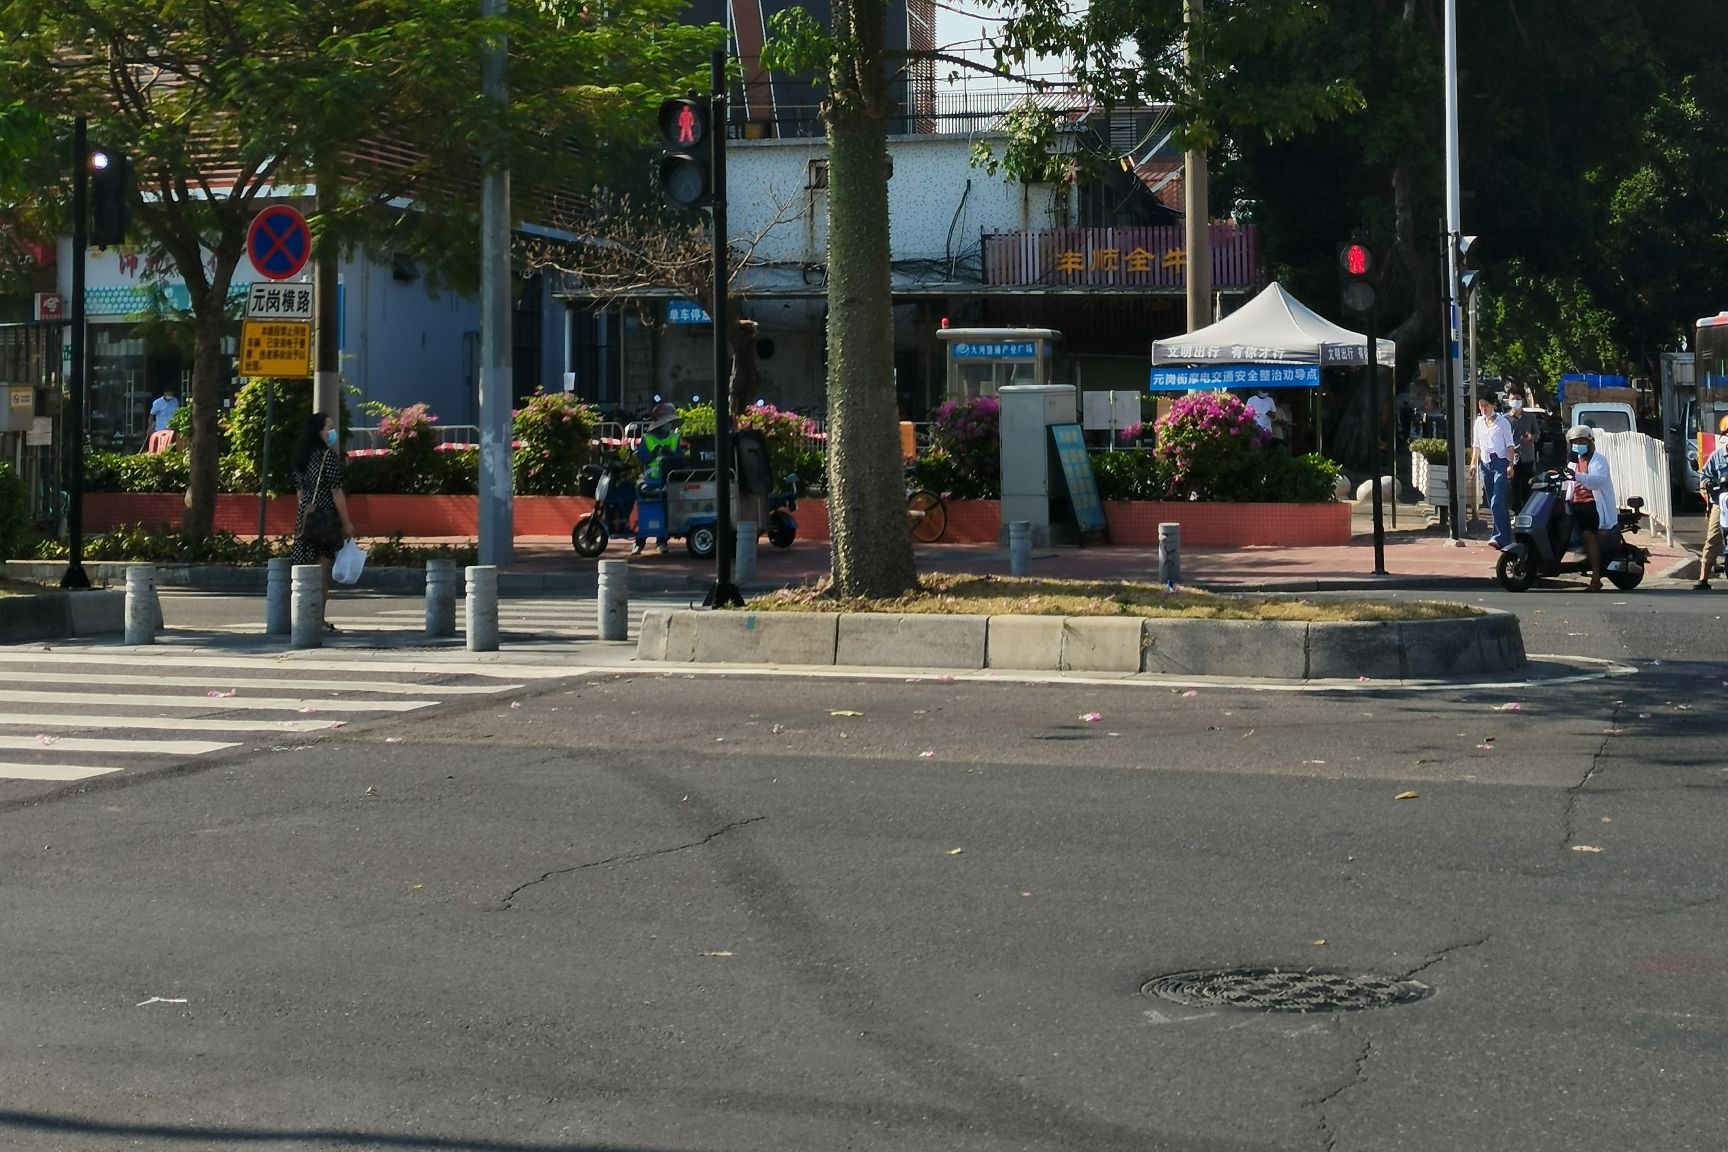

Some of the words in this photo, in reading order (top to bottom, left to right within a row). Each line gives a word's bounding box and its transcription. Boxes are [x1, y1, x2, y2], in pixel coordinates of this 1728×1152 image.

[251, 289, 310, 313] 元岗横路
[1167, 346, 1220, 358] 文明出行
[1231, 346, 1286, 359] 有你才行
[1153, 367, 1318, 386] 元岗街摩电交通安全整治劝导点
